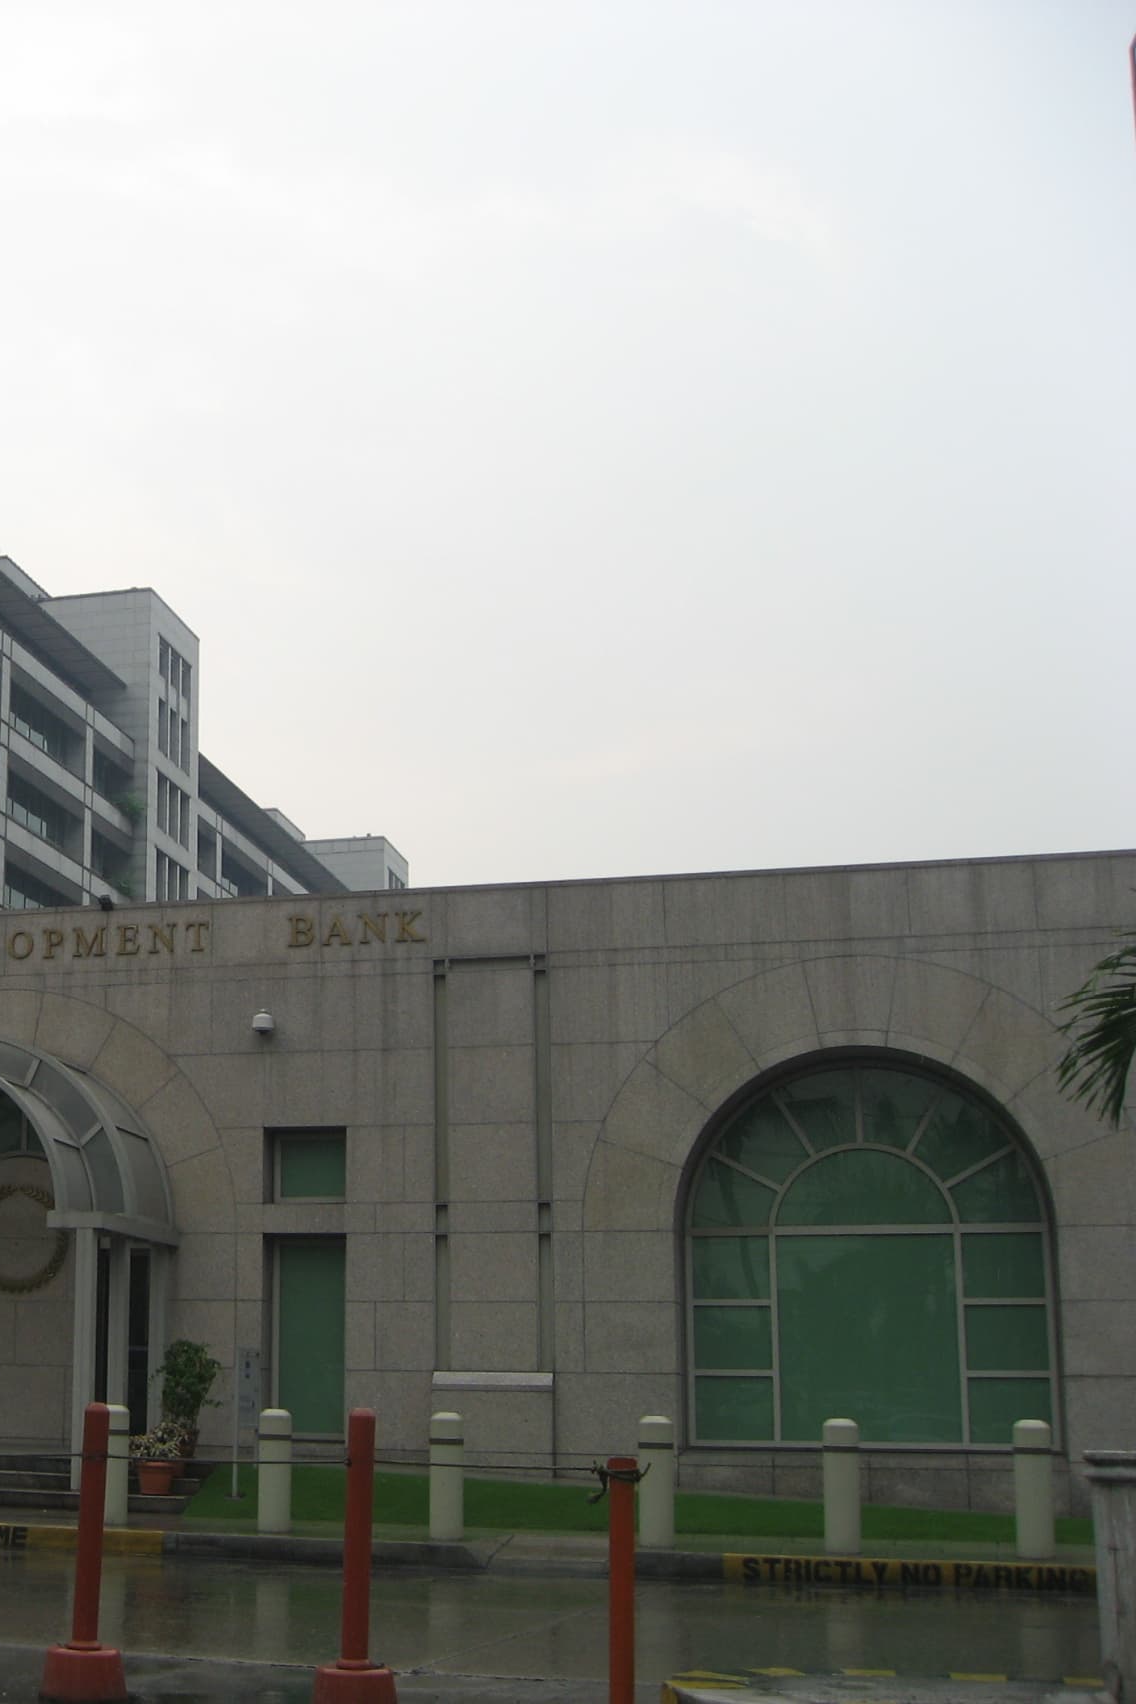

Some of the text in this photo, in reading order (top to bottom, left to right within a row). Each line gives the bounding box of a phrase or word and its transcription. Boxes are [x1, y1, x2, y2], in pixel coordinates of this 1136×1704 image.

[287, 911, 426, 948] BANK
[741, 1556, 1090, 1594] STRICTLY NO PARKING
